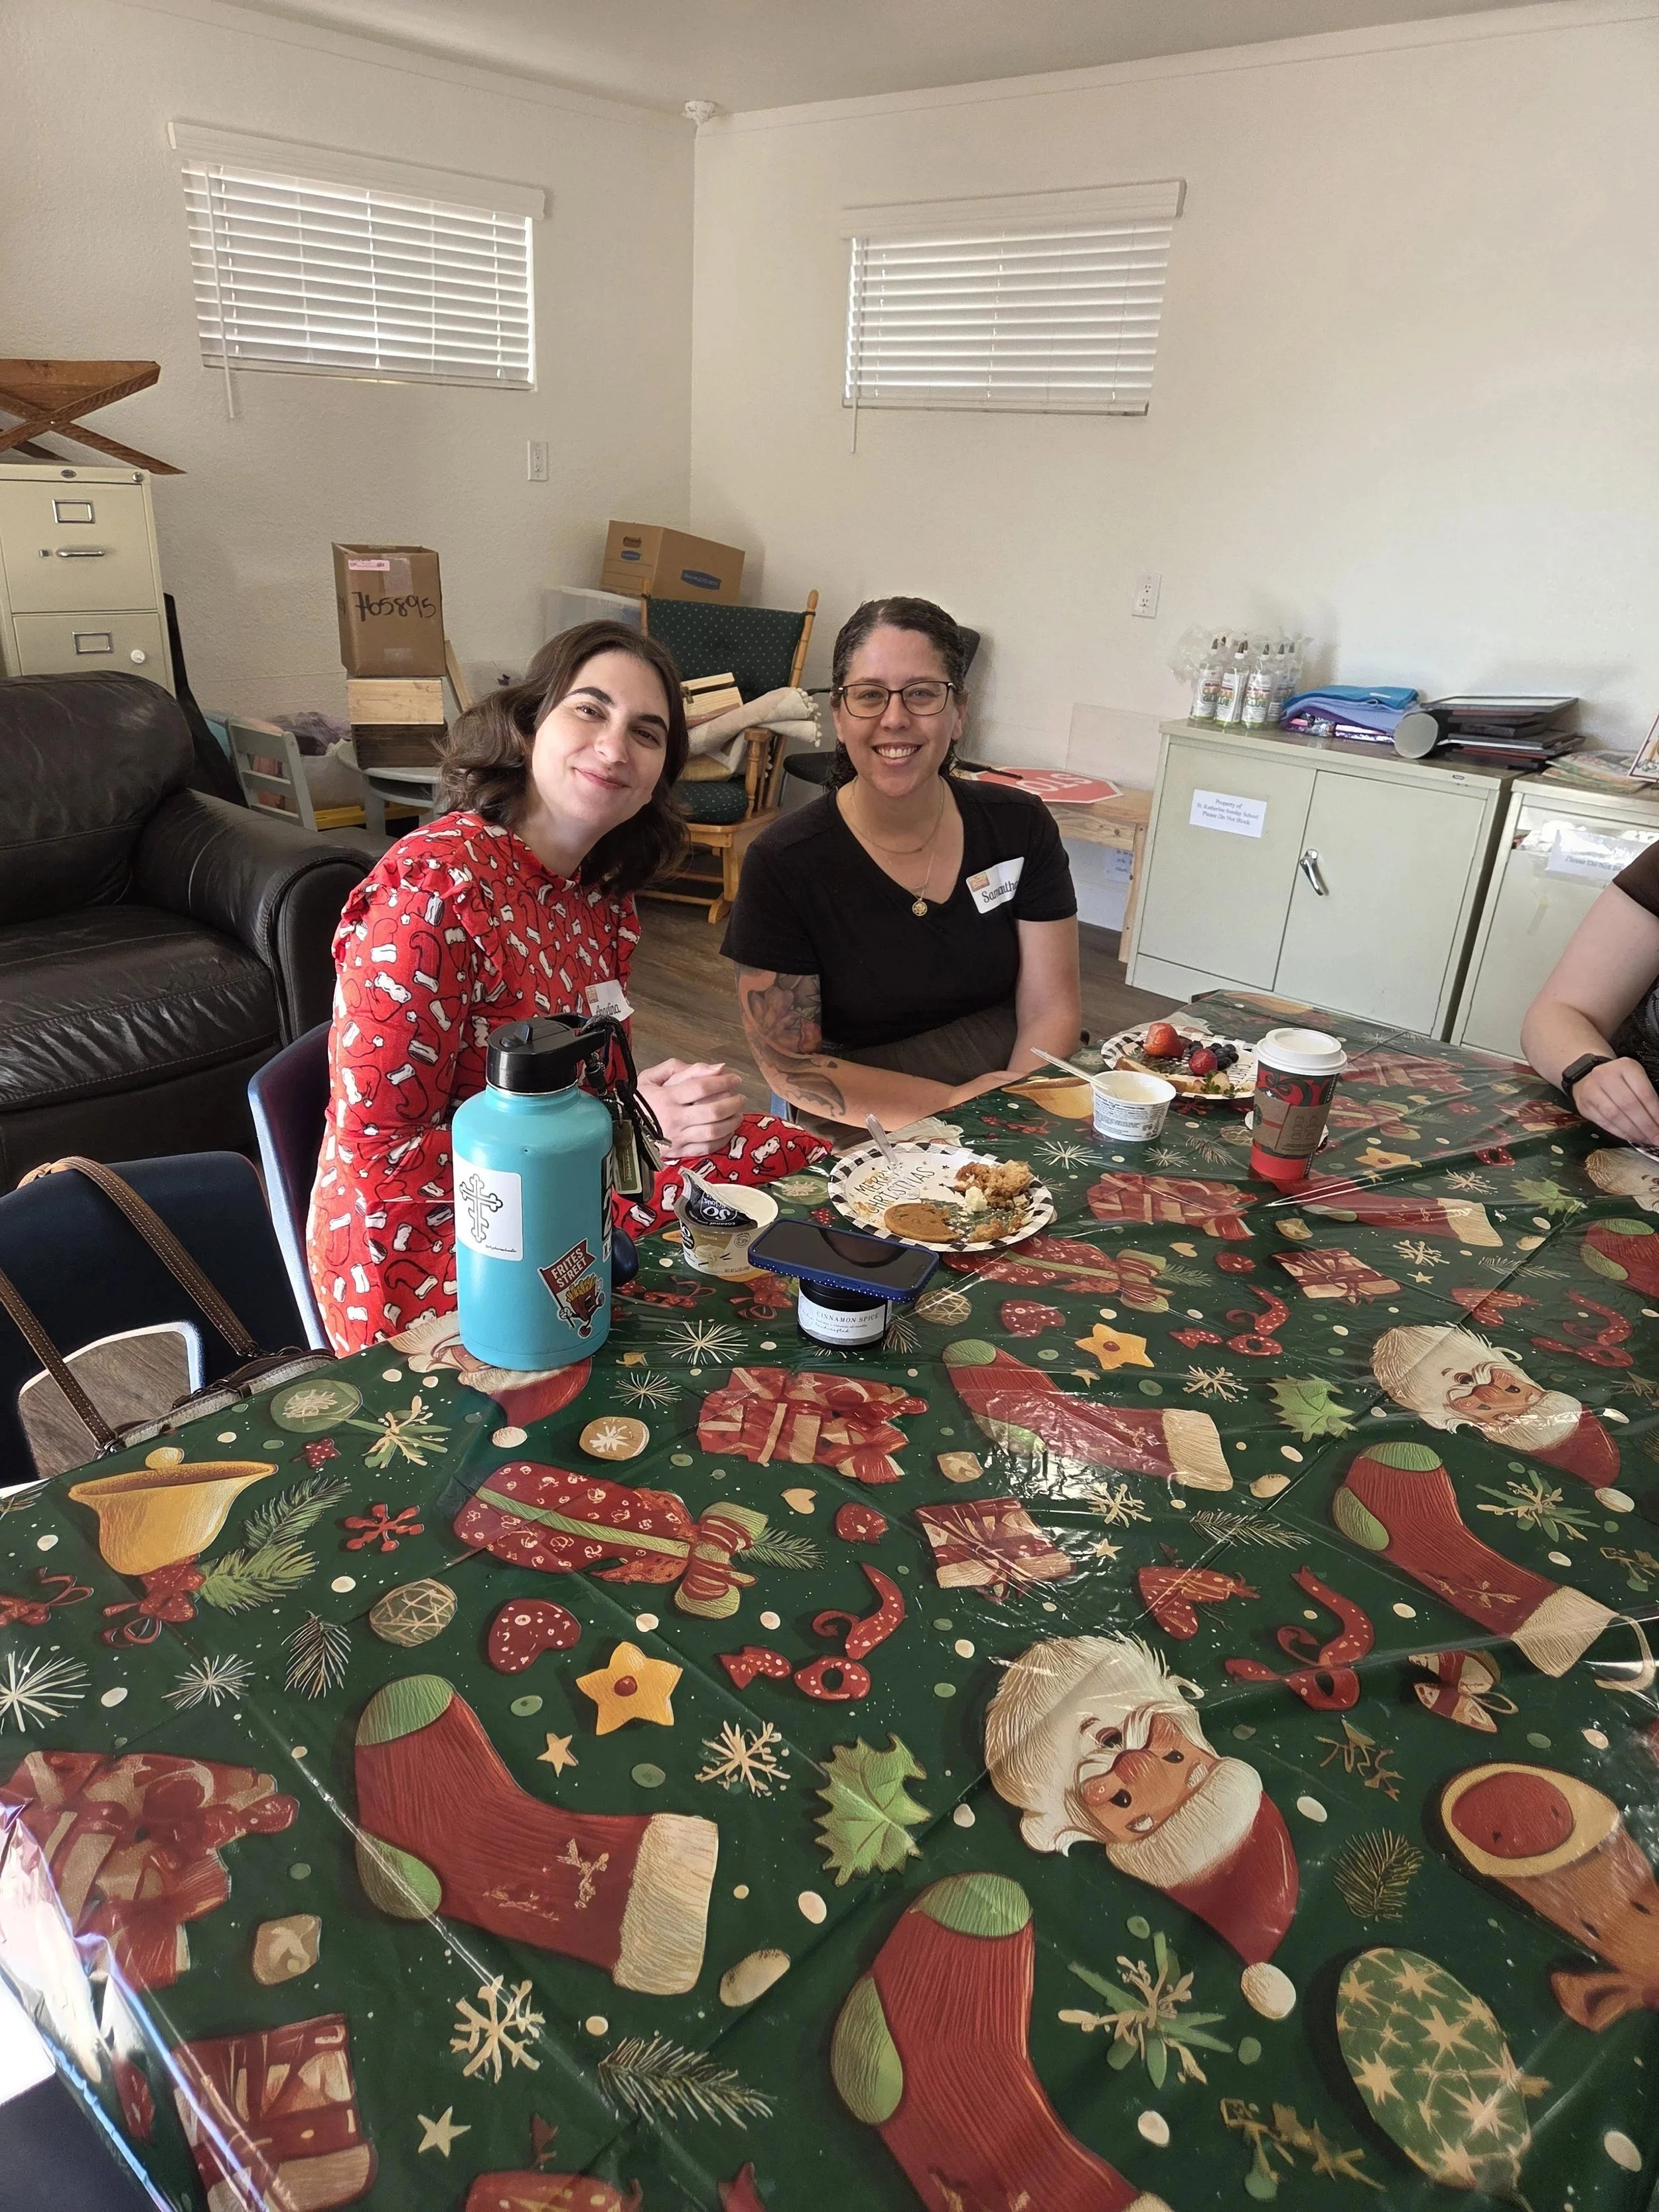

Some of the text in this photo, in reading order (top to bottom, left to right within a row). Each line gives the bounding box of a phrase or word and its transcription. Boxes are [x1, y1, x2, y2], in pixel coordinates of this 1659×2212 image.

[1015, 773, 1092, 792] STO
[1215, 798, 1235, 808] Property
[868, 1166, 936, 1214] CHRISTMAS
[702, 1206, 731, 1220] SO
[551, 1248, 583, 1280] FRITES
[556, 1256, 587, 1288] STREET
[816, 1311, 857, 1323] CINNAMON
[858, 1313, 879, 1323] SPICE
